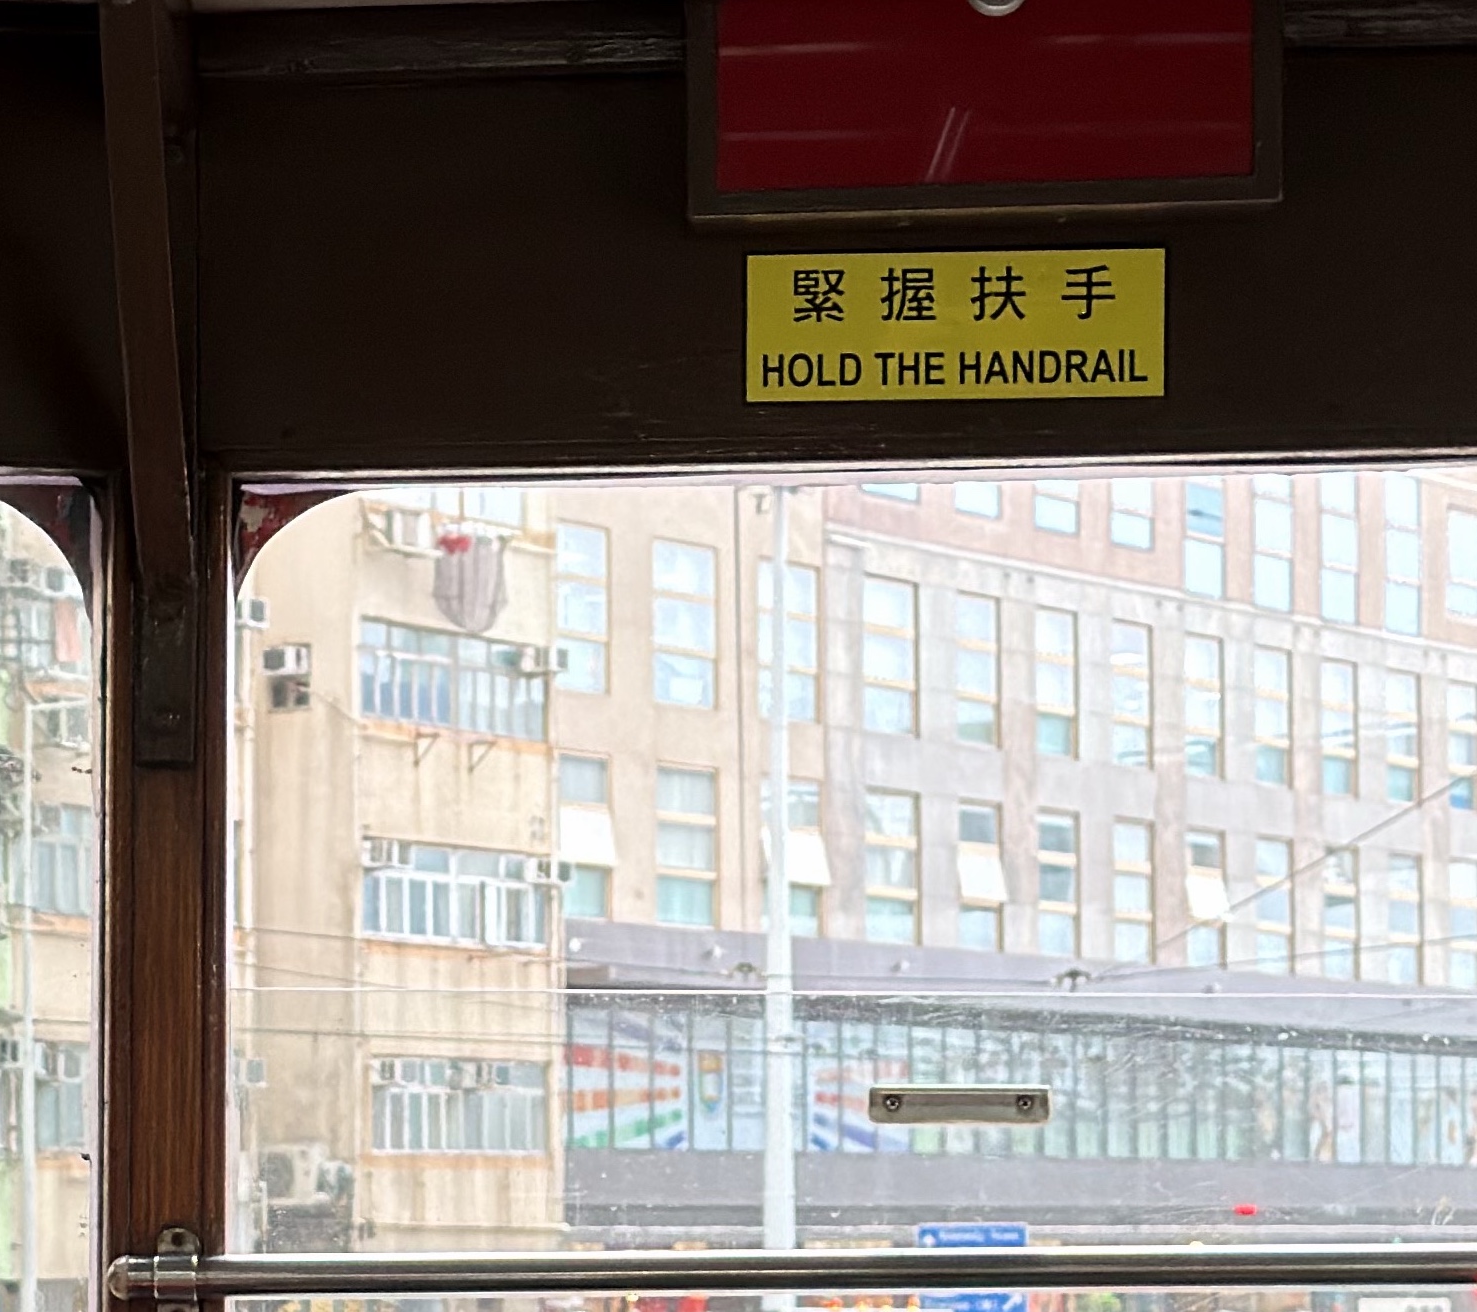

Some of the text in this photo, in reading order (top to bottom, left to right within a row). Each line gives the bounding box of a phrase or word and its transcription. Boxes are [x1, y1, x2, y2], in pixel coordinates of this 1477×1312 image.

[791, 263, 1117, 324] 緊握扶手
[761, 348, 1149, 389] HOLD THE HANDRAIL
